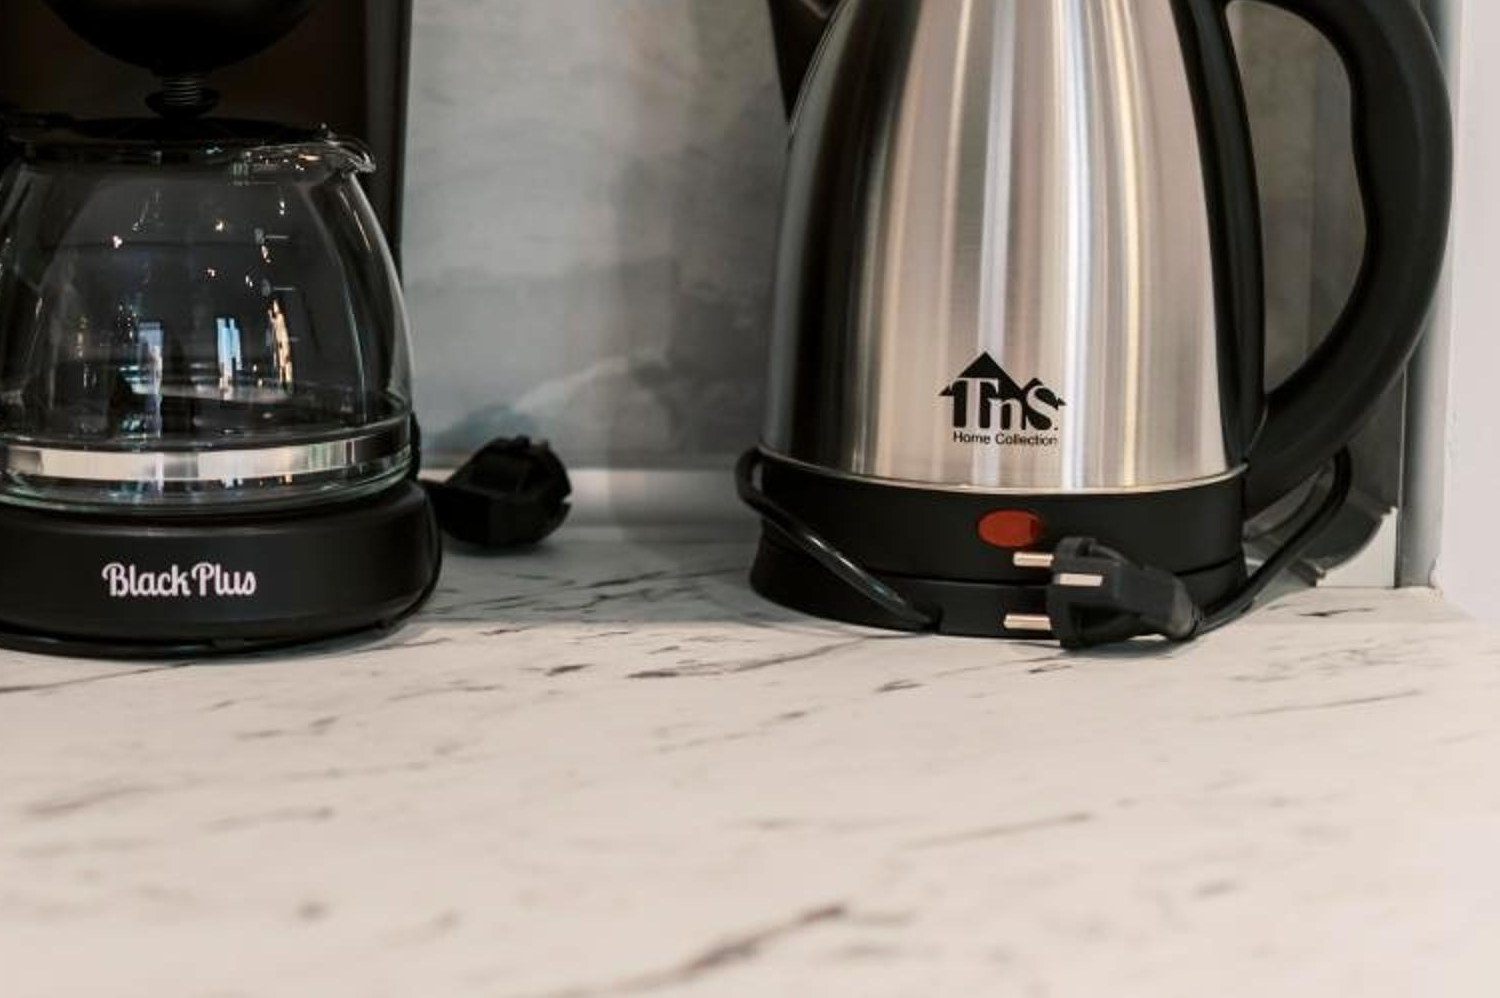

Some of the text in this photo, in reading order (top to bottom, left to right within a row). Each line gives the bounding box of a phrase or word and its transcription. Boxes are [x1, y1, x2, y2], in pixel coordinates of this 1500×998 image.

[952, 430, 1058, 446] Home Collection
[101, 561, 257, 597] Black Plus
